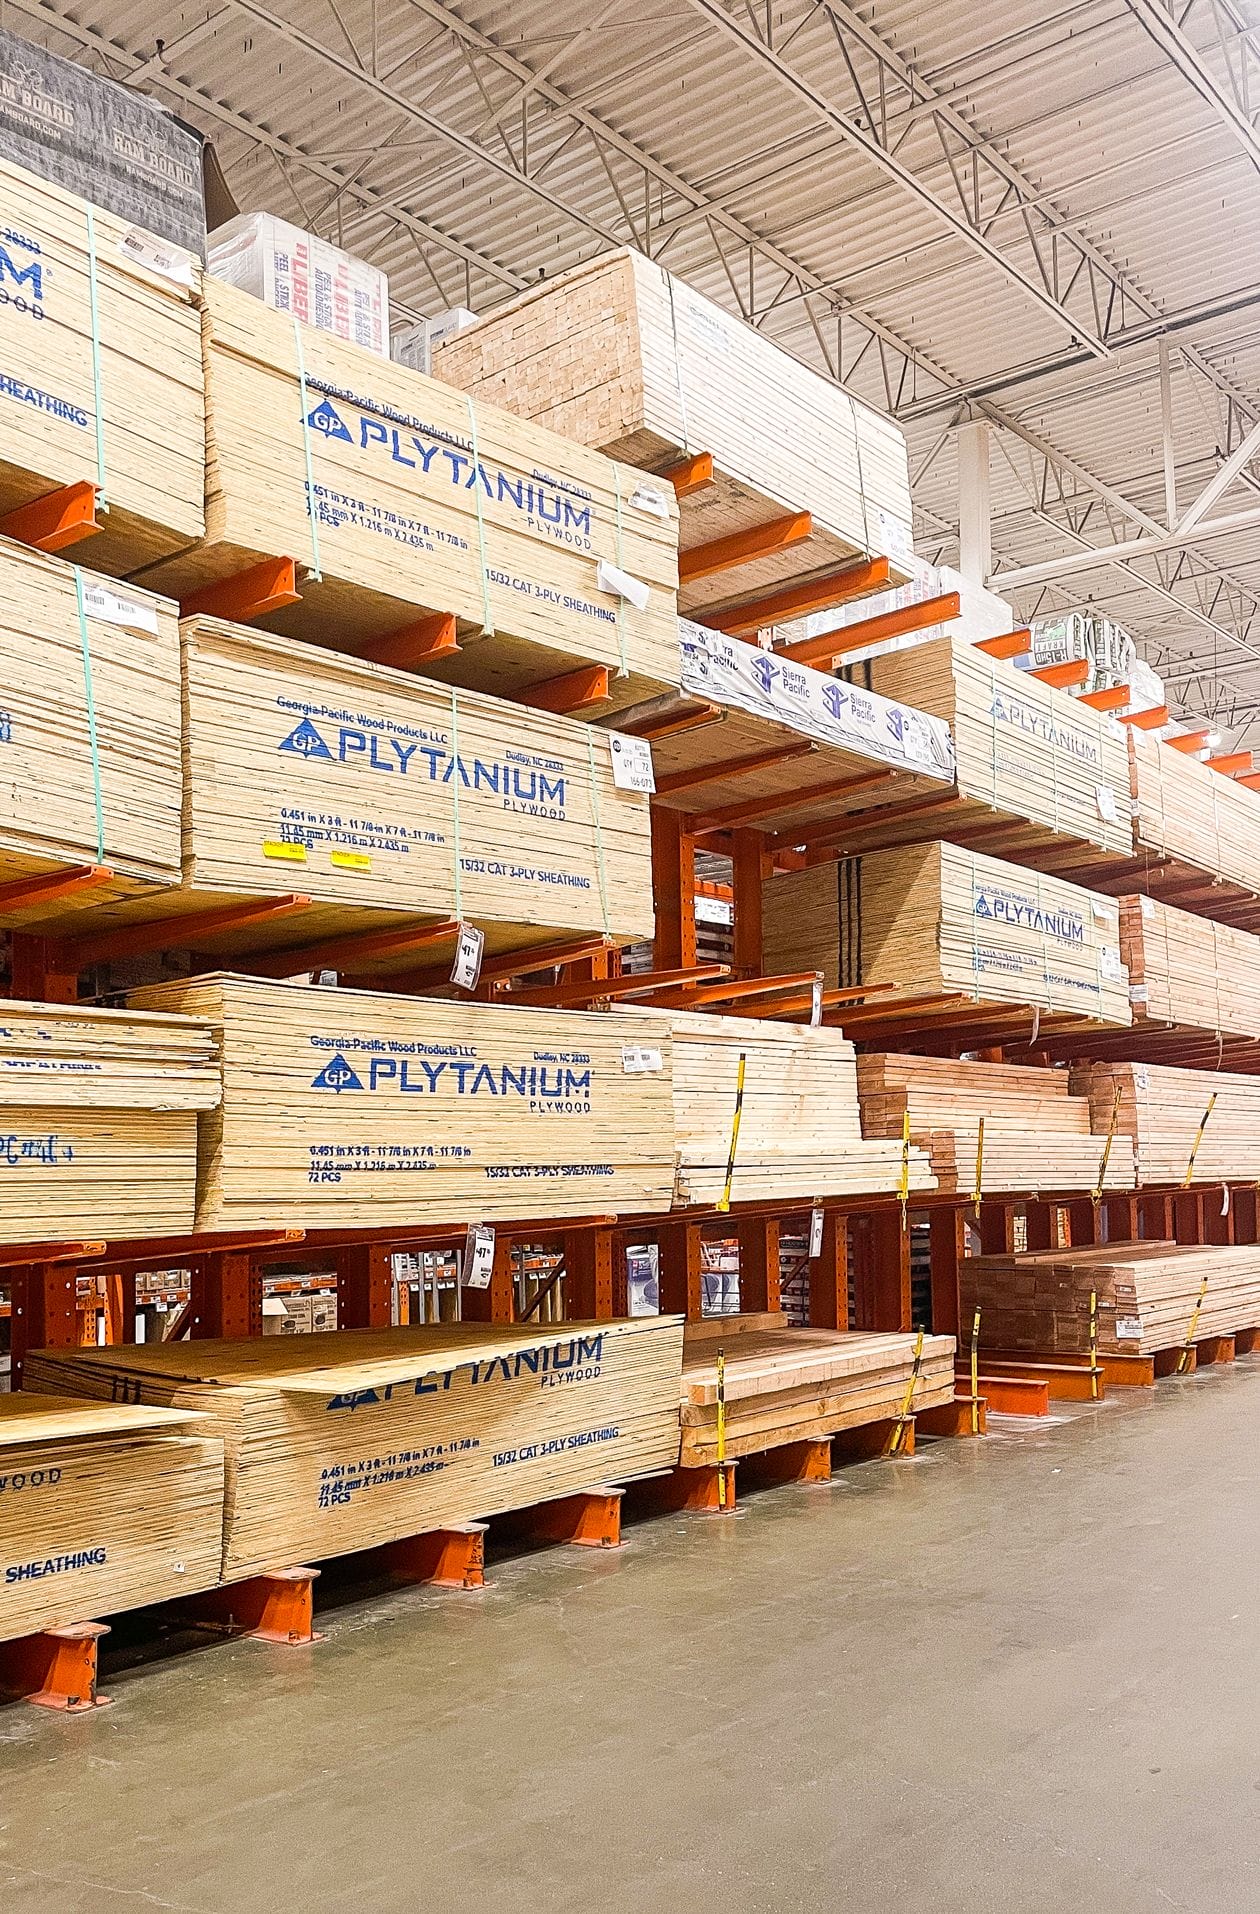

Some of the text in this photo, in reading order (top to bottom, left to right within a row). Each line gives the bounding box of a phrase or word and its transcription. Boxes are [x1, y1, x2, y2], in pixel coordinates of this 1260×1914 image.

[21, 88, 75, 127] BOARD
[114, 133, 193, 187] RAM BOARD
[314, 412, 342, 433] GP
[383, 404, 410, 426] Wood
[360, 416, 591, 535] PLYTANIUM
[304, 481, 329, 499] 0451
[342, 495, 349, 506] X
[408, 520, 415, 531] X
[331, 505, 349, 521] mm
[350, 512, 358, 525] X
[394, 528, 401, 540] X
[527, 516, 592, 550] PLYWOOD
[485, 567, 617, 625] 15/32 CAT 3-PLY SHEATHING
[782, 665, 807, 686] Sierra
[783, 678, 811, 699] Pacific
[850, 692, 873, 711] Sierra
[851, 704, 876, 723] Pacific
[276, 695, 449, 744] Georgia-Pacific Wood Products LLC
[292, 732, 321, 752] GP
[1009, 703, 1098, 764] PLYTANIUM
[339, 728, 566, 807] PLYTANIUM
[505, 750, 531, 767] Dudley,
[532, 757, 544, 768] NC
[503, 799, 567, 822] PLYWOOD
[280, 808, 306, 822] 0.451
[307, 812, 317, 824] in
[319, 814, 326, 825] X
[350, 819, 359, 830] 11
[385, 824, 393, 835] X
[437, 833, 446, 844] in
[307, 828, 325, 840] mm
[325, 830, 332, 841] X
[359, 838, 368, 846] m
[369, 836, 377, 848] X
[401, 844, 410, 853] m
[459, 858, 591, 889] 15/32 CAT 3-PLY SHEATHING
[993, 899, 1083, 942] PLYTANIUM
[310, 1035, 478, 1057] Georgia-Pacific Wood Products LLC
[533, 1051, 559, 1064] Dudley,
[559, 1053, 571, 1063] NC
[323, 1069, 352, 1086] GP
[369, 1057, 591, 1098] PLYTANIUM
[529, 1101, 591, 1113] PLYWOOD
[347, 1146, 355, 1156] X
[412, 1147, 420, 1156] X
[308, 1172, 342, 1182] 72 PCS
[511, 1166, 531, 1177] CAT
[541, 1366, 601, 1389] PLYWOOD
[492, 1426, 620, 1467] 15/32 CAT 3-PLY SHEATHING
[321, 1465, 345, 1480] 0.451
[347, 1464, 356, 1474] in
[358, 1462, 365, 1472] X
[412, 1451, 421, 1461] in
[422, 1448, 429, 1458] X
[318, 1491, 351, 1508] 72 PCS
[5, 1547, 107, 1584] SHEATHING
